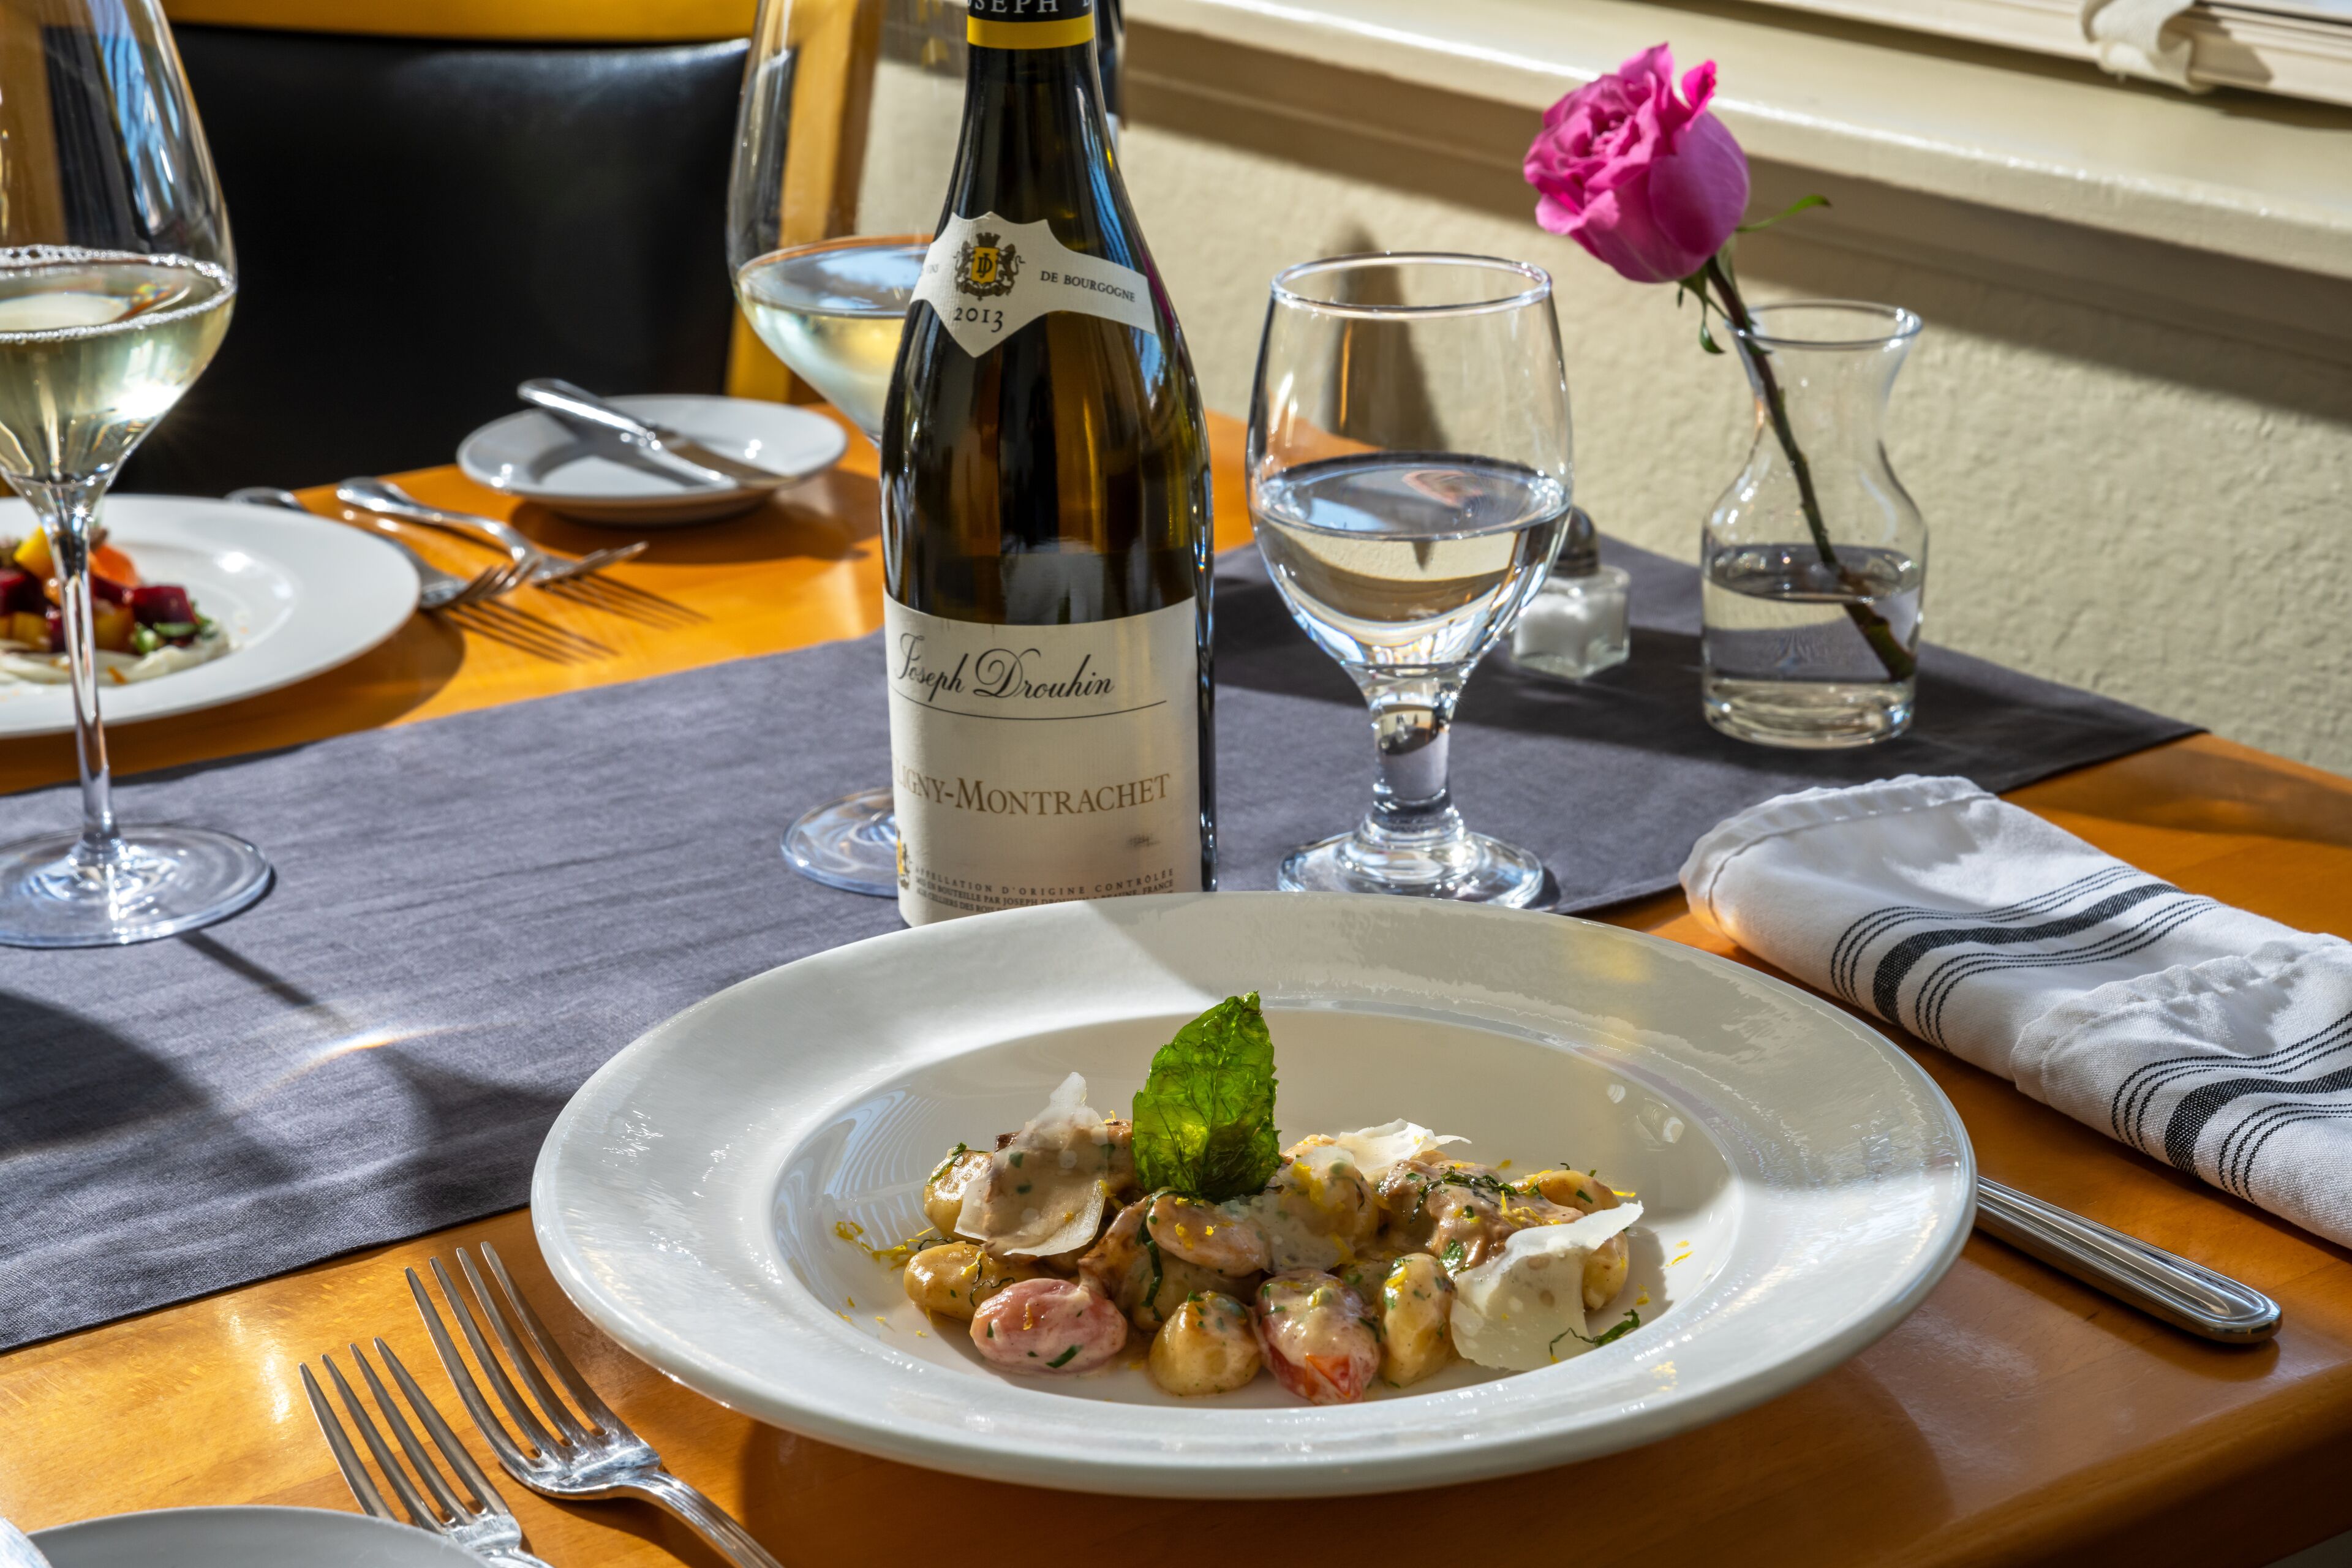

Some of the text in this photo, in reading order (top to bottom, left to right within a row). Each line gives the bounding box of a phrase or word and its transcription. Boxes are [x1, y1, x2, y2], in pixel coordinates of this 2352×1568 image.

[1040, 271, 1136, 303] DE BOURGOGNE
[954, 307, 1003, 333] 2013
[897, 633, 1115, 702] Joseph Drouhin
[916, 867, 992, 892] APPELLATION
[1001, 886, 1085, 895] D'ORIGINE
[938, 885, 981, 902] BOUTEILLE
[984, 895, 1001, 903] PAR
[1003, 897, 1038, 906] JOSEPH
[1142, 879, 1173, 894] FRANCE
